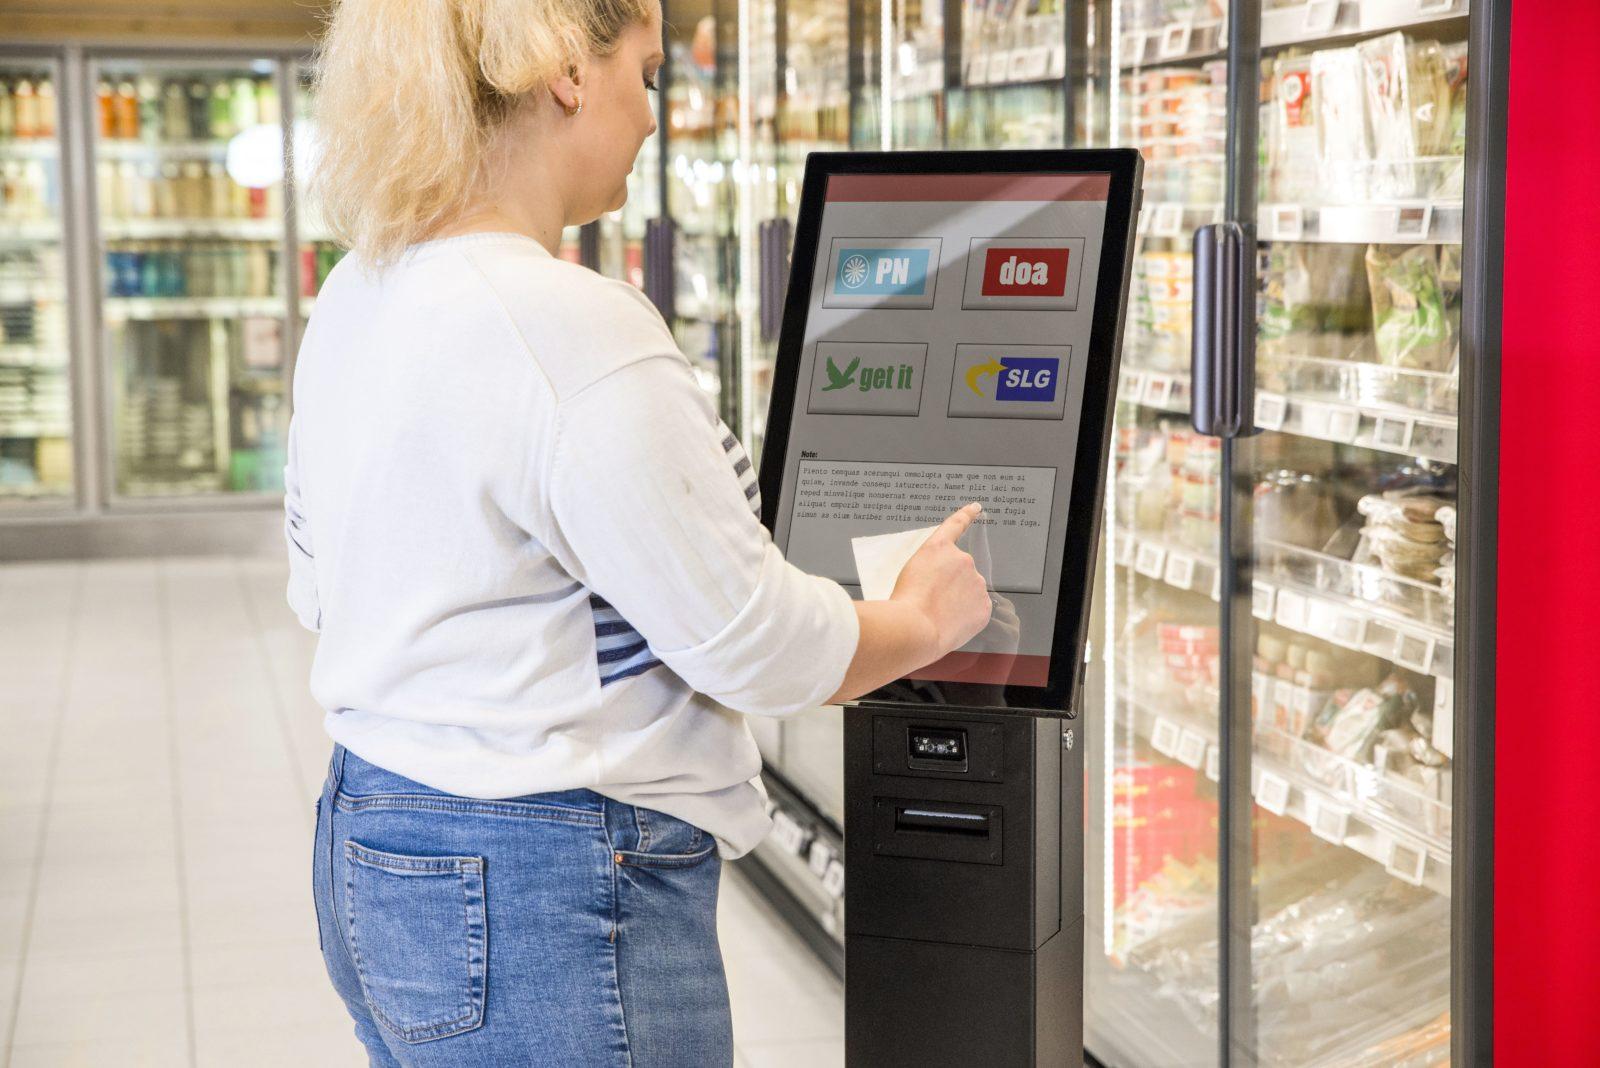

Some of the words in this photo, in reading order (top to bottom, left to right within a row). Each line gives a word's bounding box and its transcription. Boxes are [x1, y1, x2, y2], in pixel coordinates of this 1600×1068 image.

[875, 258, 910, 285] PN
[999, 256, 1049, 286] doa
[859, 365, 895, 392] get
[897, 364, 914, 390] it
[1006, 368, 1051, 389] SLG
[801, 450, 818, 458] Note:
[967, 473, 980, 481] que
